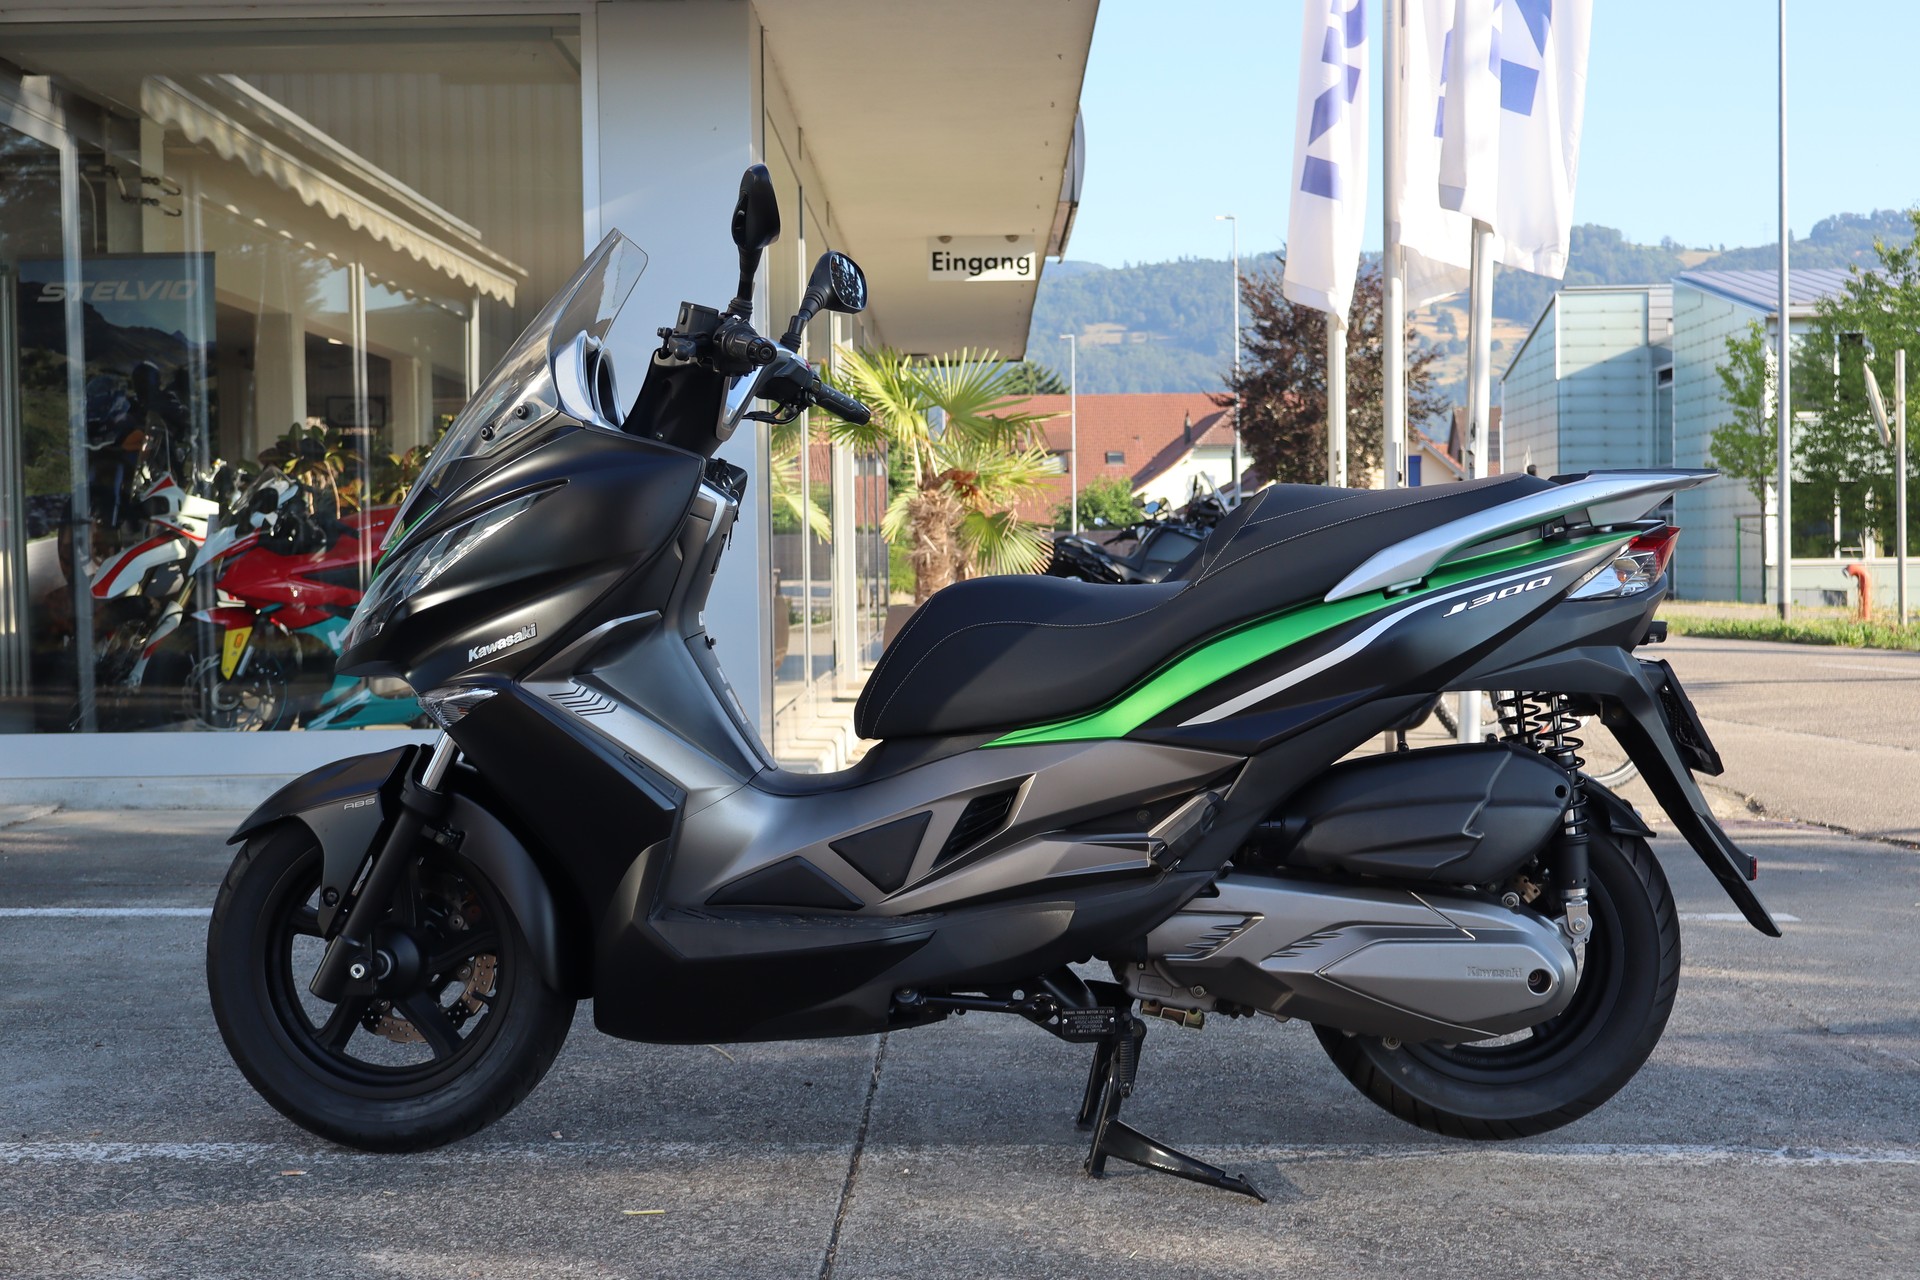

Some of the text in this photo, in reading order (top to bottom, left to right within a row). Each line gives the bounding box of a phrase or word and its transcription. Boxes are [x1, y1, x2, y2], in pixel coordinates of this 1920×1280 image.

[931, 251, 1030, 276] Eingang
[37, 279, 197, 303] STELVIO
[468, 622, 537, 663] Kawasaki
[343, 797, 376, 810] ABS
[1466, 966, 1523, 979] Kawasaki
